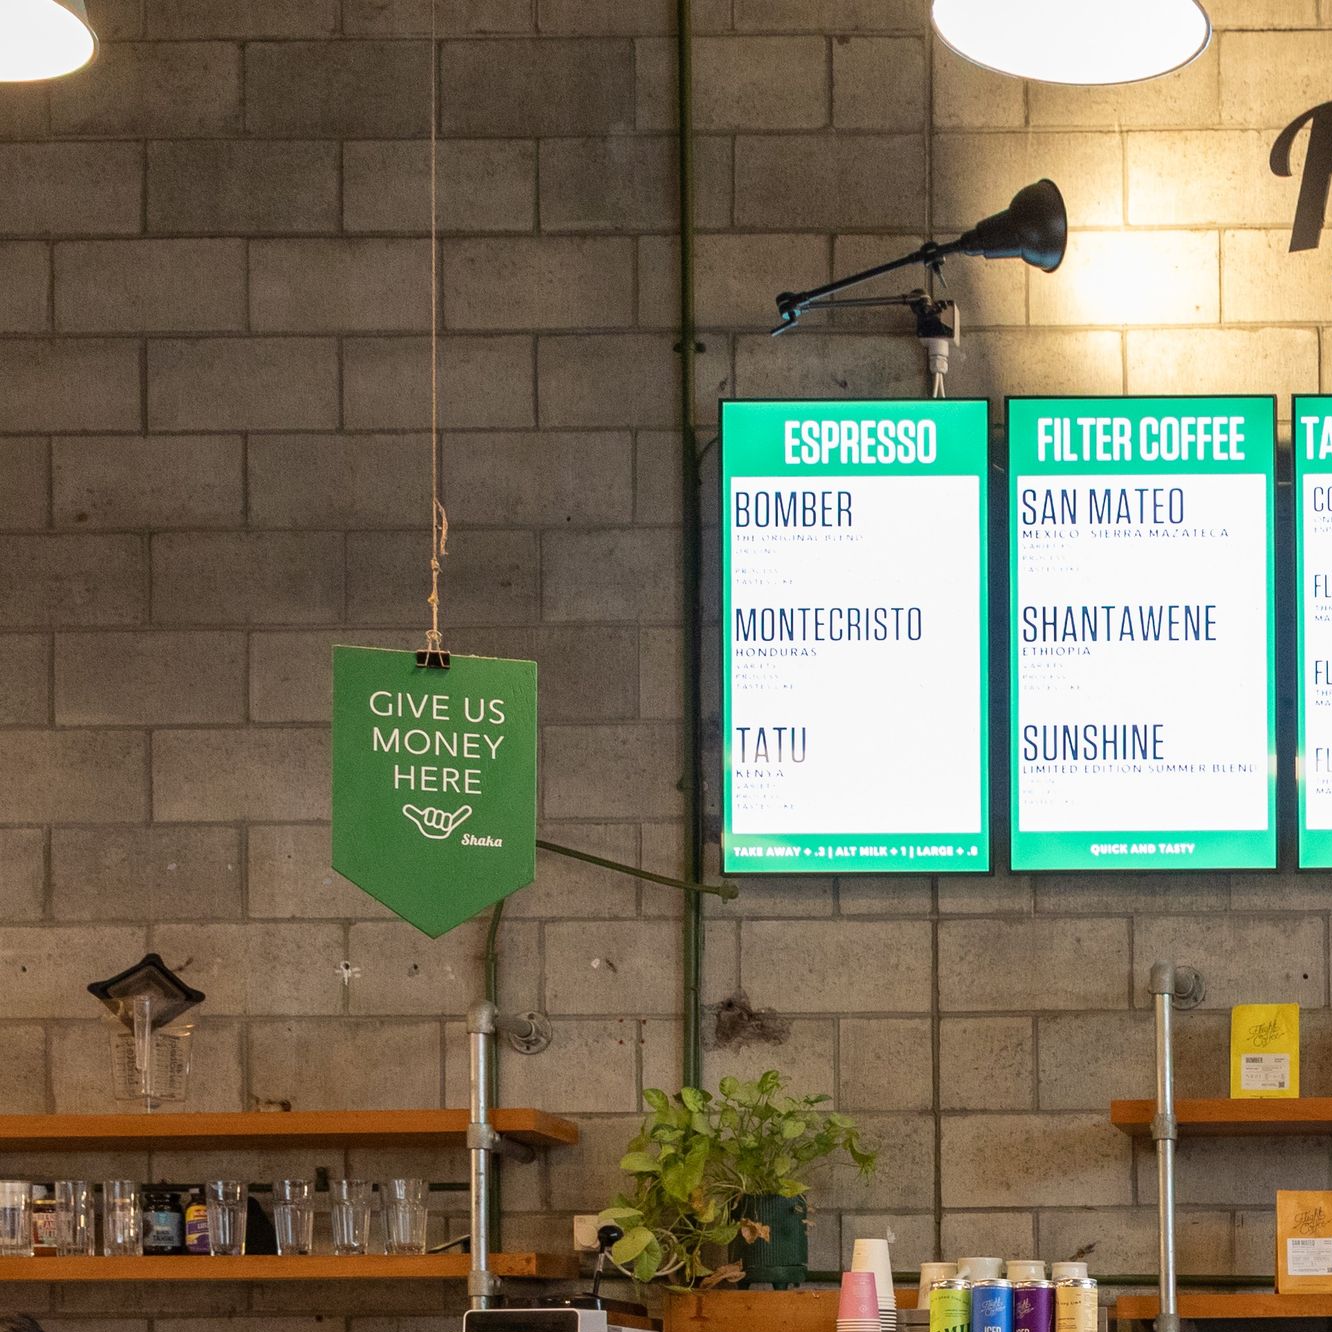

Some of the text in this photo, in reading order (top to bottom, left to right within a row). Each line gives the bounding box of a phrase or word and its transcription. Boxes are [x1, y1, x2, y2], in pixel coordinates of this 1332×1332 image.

[785, 419, 937, 464] ESPRESSO
[1037, 416, 1245, 462] FILTER COFFEE
[735, 491, 852, 528] BOMBER
[1022, 488, 1184, 525] SAN MATEO
[735, 607, 922, 641] MONTECRISTO
[1023, 605, 1216, 642] SHANTAWENE
[736, 648, 817, 657] HONDURAS
[1023, 647, 1091, 656] ETHIOPIA
[369, 691, 505, 724] GIVE US
[373, 727, 505, 759] MONEY
[736, 727, 806, 762] TATU
[1023, 724, 1164, 761] SUNSHINE
[394, 765, 482, 794] HERE
[461, 833, 502, 847] Shaka
[1090, 843, 1195, 856] QUICK AND TASTY
